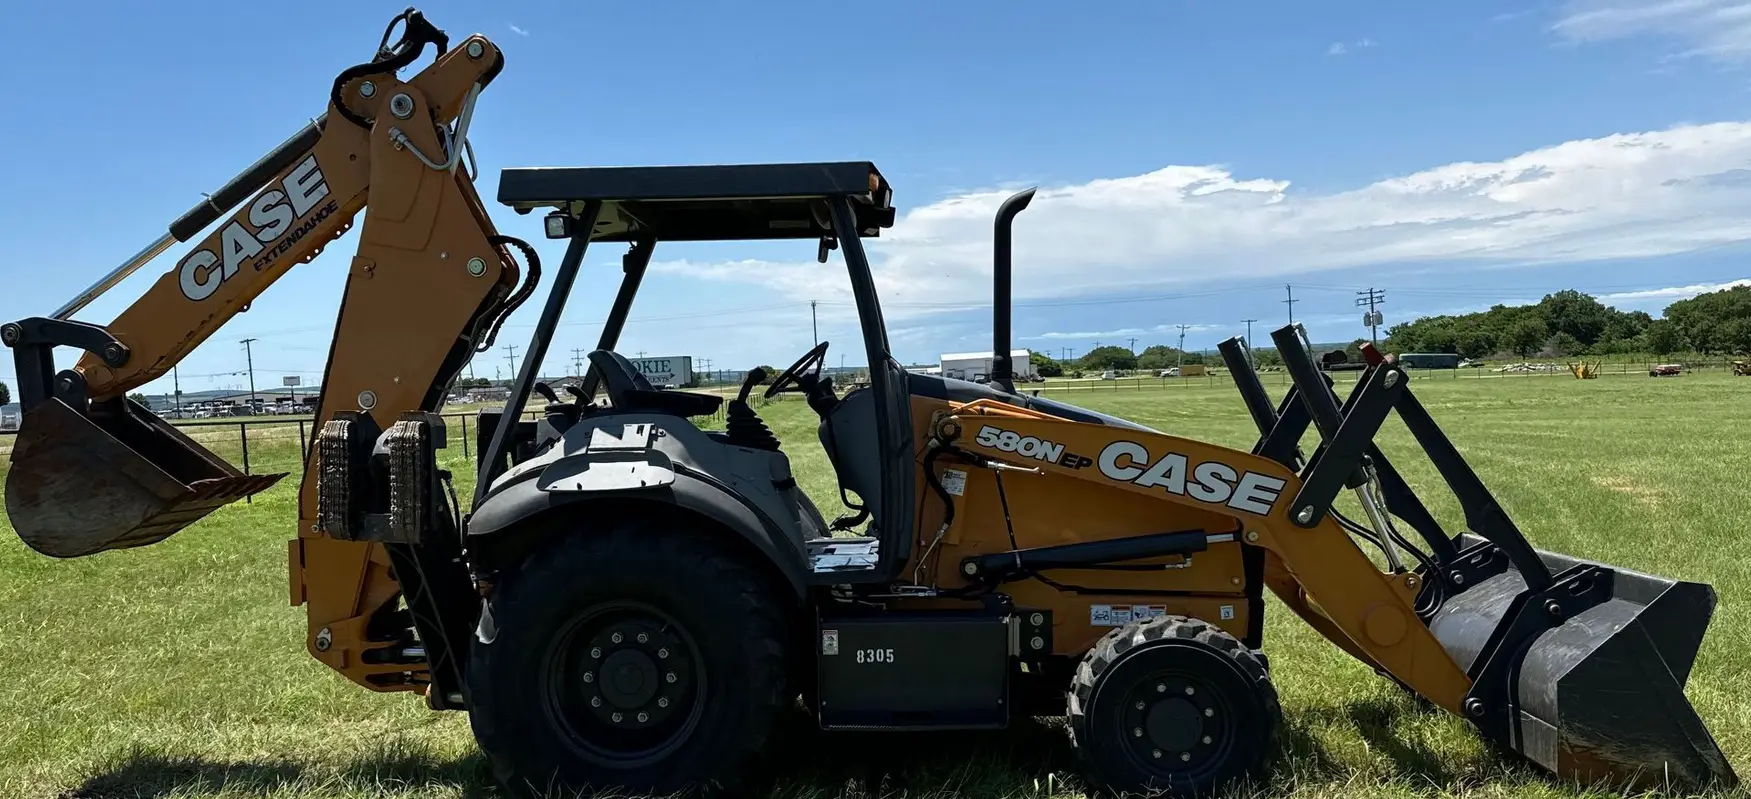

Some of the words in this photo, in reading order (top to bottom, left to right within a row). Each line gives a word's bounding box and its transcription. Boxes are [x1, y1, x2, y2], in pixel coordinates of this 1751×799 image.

[179, 153, 331, 301] CASE
[253, 200, 339, 272] EXTENDAHOE
[975, 425, 1066, 464] 580N
[1060, 452, 1093, 470] EP
[1098, 440, 1287, 516] CASE
[856, 649, 894, 663] 8305
